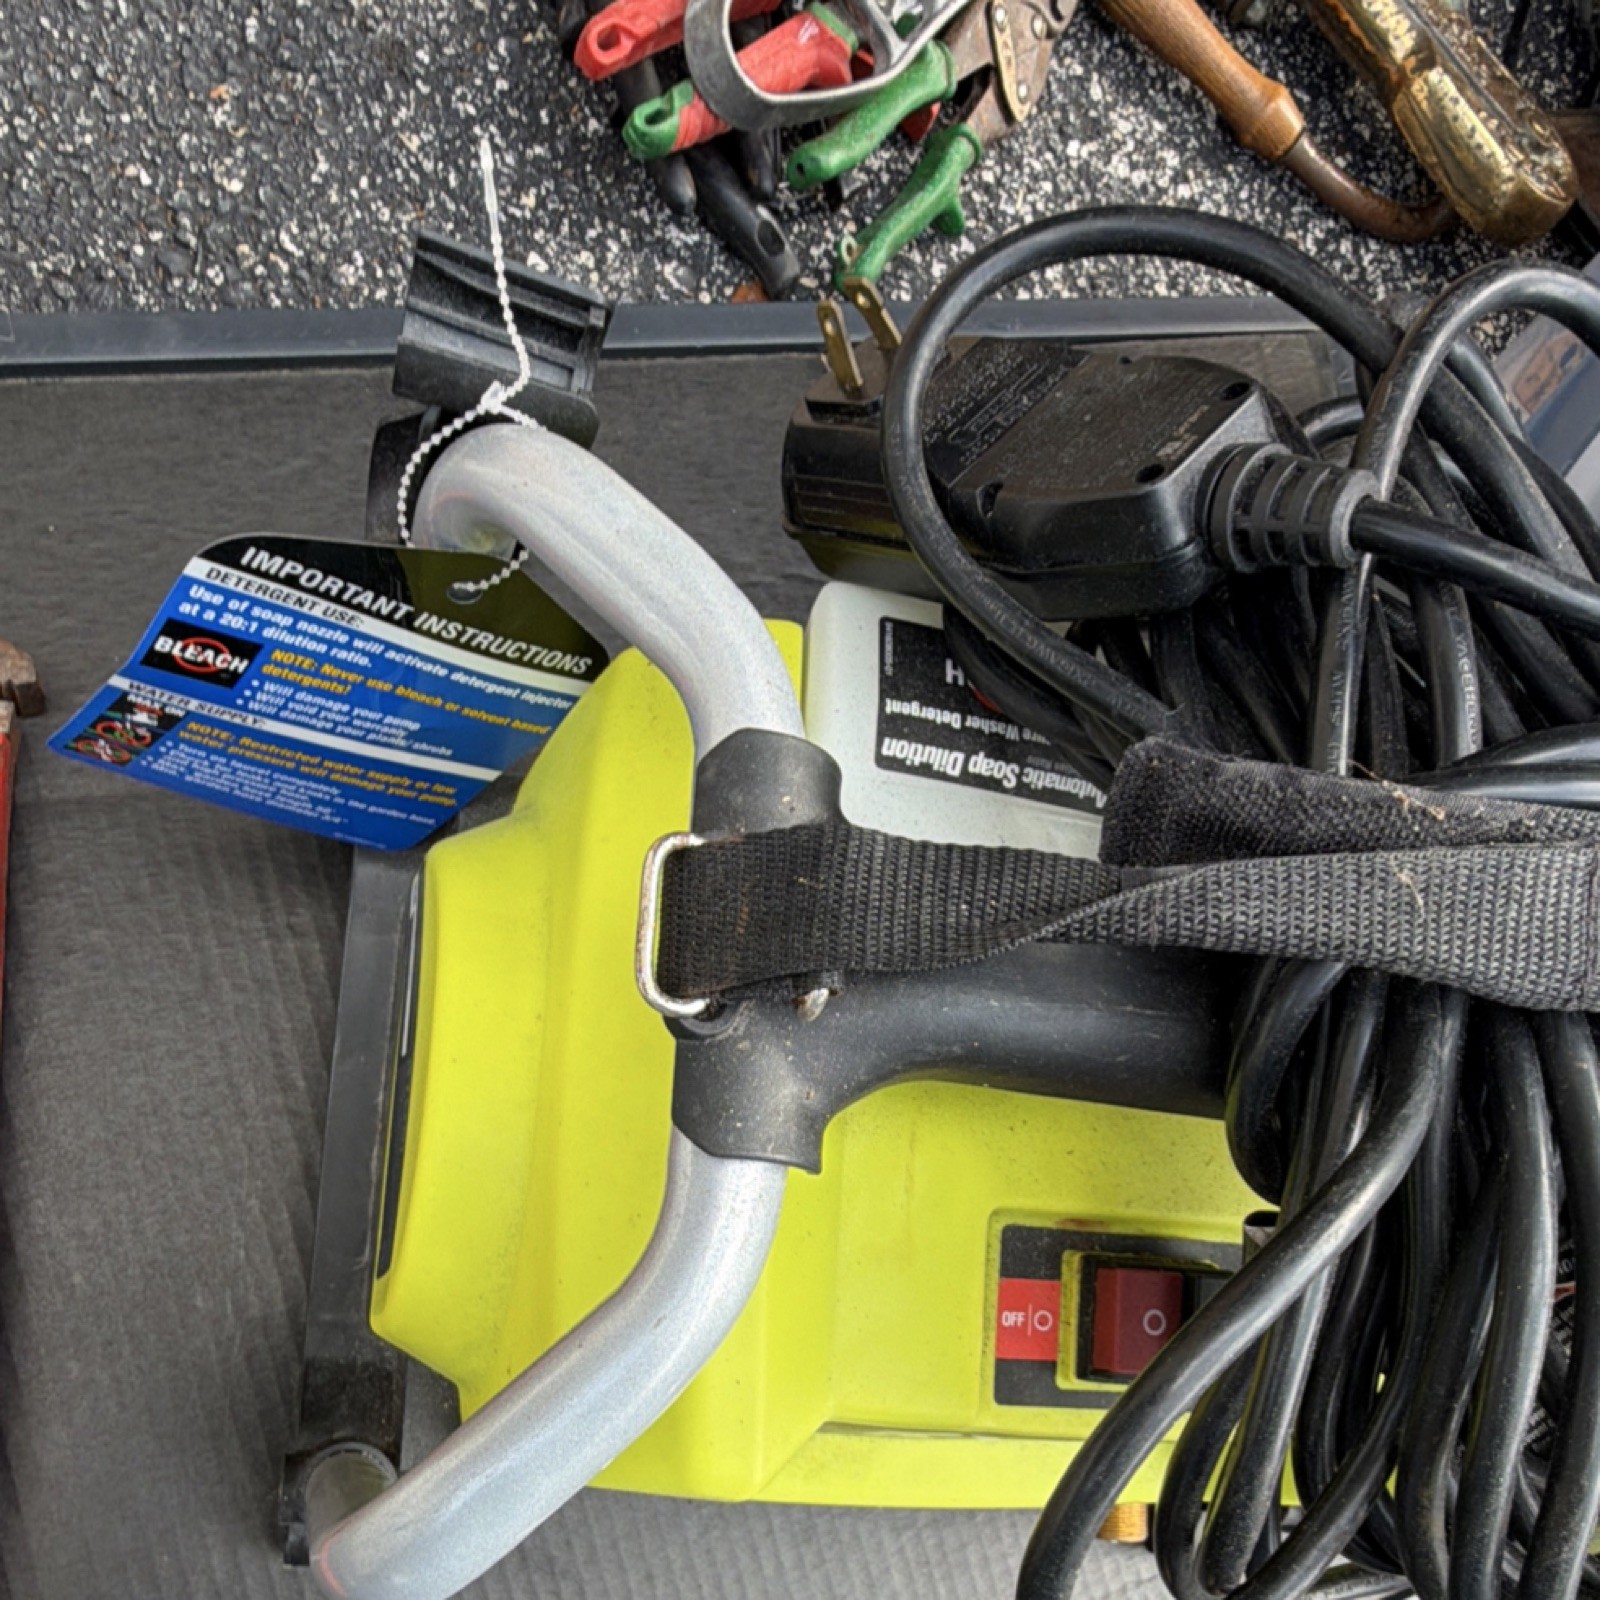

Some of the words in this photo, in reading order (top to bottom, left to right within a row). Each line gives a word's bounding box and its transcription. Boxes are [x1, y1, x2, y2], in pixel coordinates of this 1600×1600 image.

[205, 567, 321, 612] DETERGENT
[322, 606, 364, 628] USE:
[241, 546, 415, 620] IMPORTANT
[413, 612, 593, 674] INSTRUCTIONS
[179, 601, 200, 617] at
[202, 608, 217, 621] a
[219, 612, 259, 633] 20:1
[261, 626, 328, 654] dilution
[330, 647, 372, 668] ratio.
[189, 584, 225, 605] Use
[228, 599, 250, 613] of
[250, 605, 294, 627] soap
[296, 620, 350, 644] nozzle
[352, 637, 385, 655] will
[384, 650, 449, 677] activate
[450, 671, 521, 698] detergent
[520, 690, 573, 709] injector
[153, 635, 250, 674] BLEACH
[128, 681, 190, 706] WATER
[261, 663, 352, 696] detergents!
[271, 648, 318, 672] NOTE:
[320, 663, 364, 684] Never
[365, 678, 393, 692] use
[395, 685, 443, 707] bleach
[444, 701, 460, 713] or
[461, 706, 512, 726] solvent
[248, 700, 279, 715] Will
[279, 709, 334, 729] damage
[335, 725, 367, 738] your
[256, 691, 286, 706] Will
[287, 702, 319, 715] void
[319, 709, 351, 723] your
[263, 681, 295, 698] Will
[294, 691, 351, 712] damage
[352, 707, 383, 721] your
[383, 715, 421, 732] pump
[884, 698, 962, 730] Detergent
[965, 714, 1020, 740] Washer
[178, 730, 225, 749] water
[227, 745, 297, 769] pressure
[186, 721, 236, 742] NOTE:
[238, 736, 321, 764] Restricted
[323, 760, 365, 776] water
[366, 770, 412, 788] supply
[881, 737, 965, 778] Dilution
[967, 751, 1020, 789] Soap
[1022, 767, 1108, 808] Automatic
[1001, 1311, 1025, 1327] OFF
